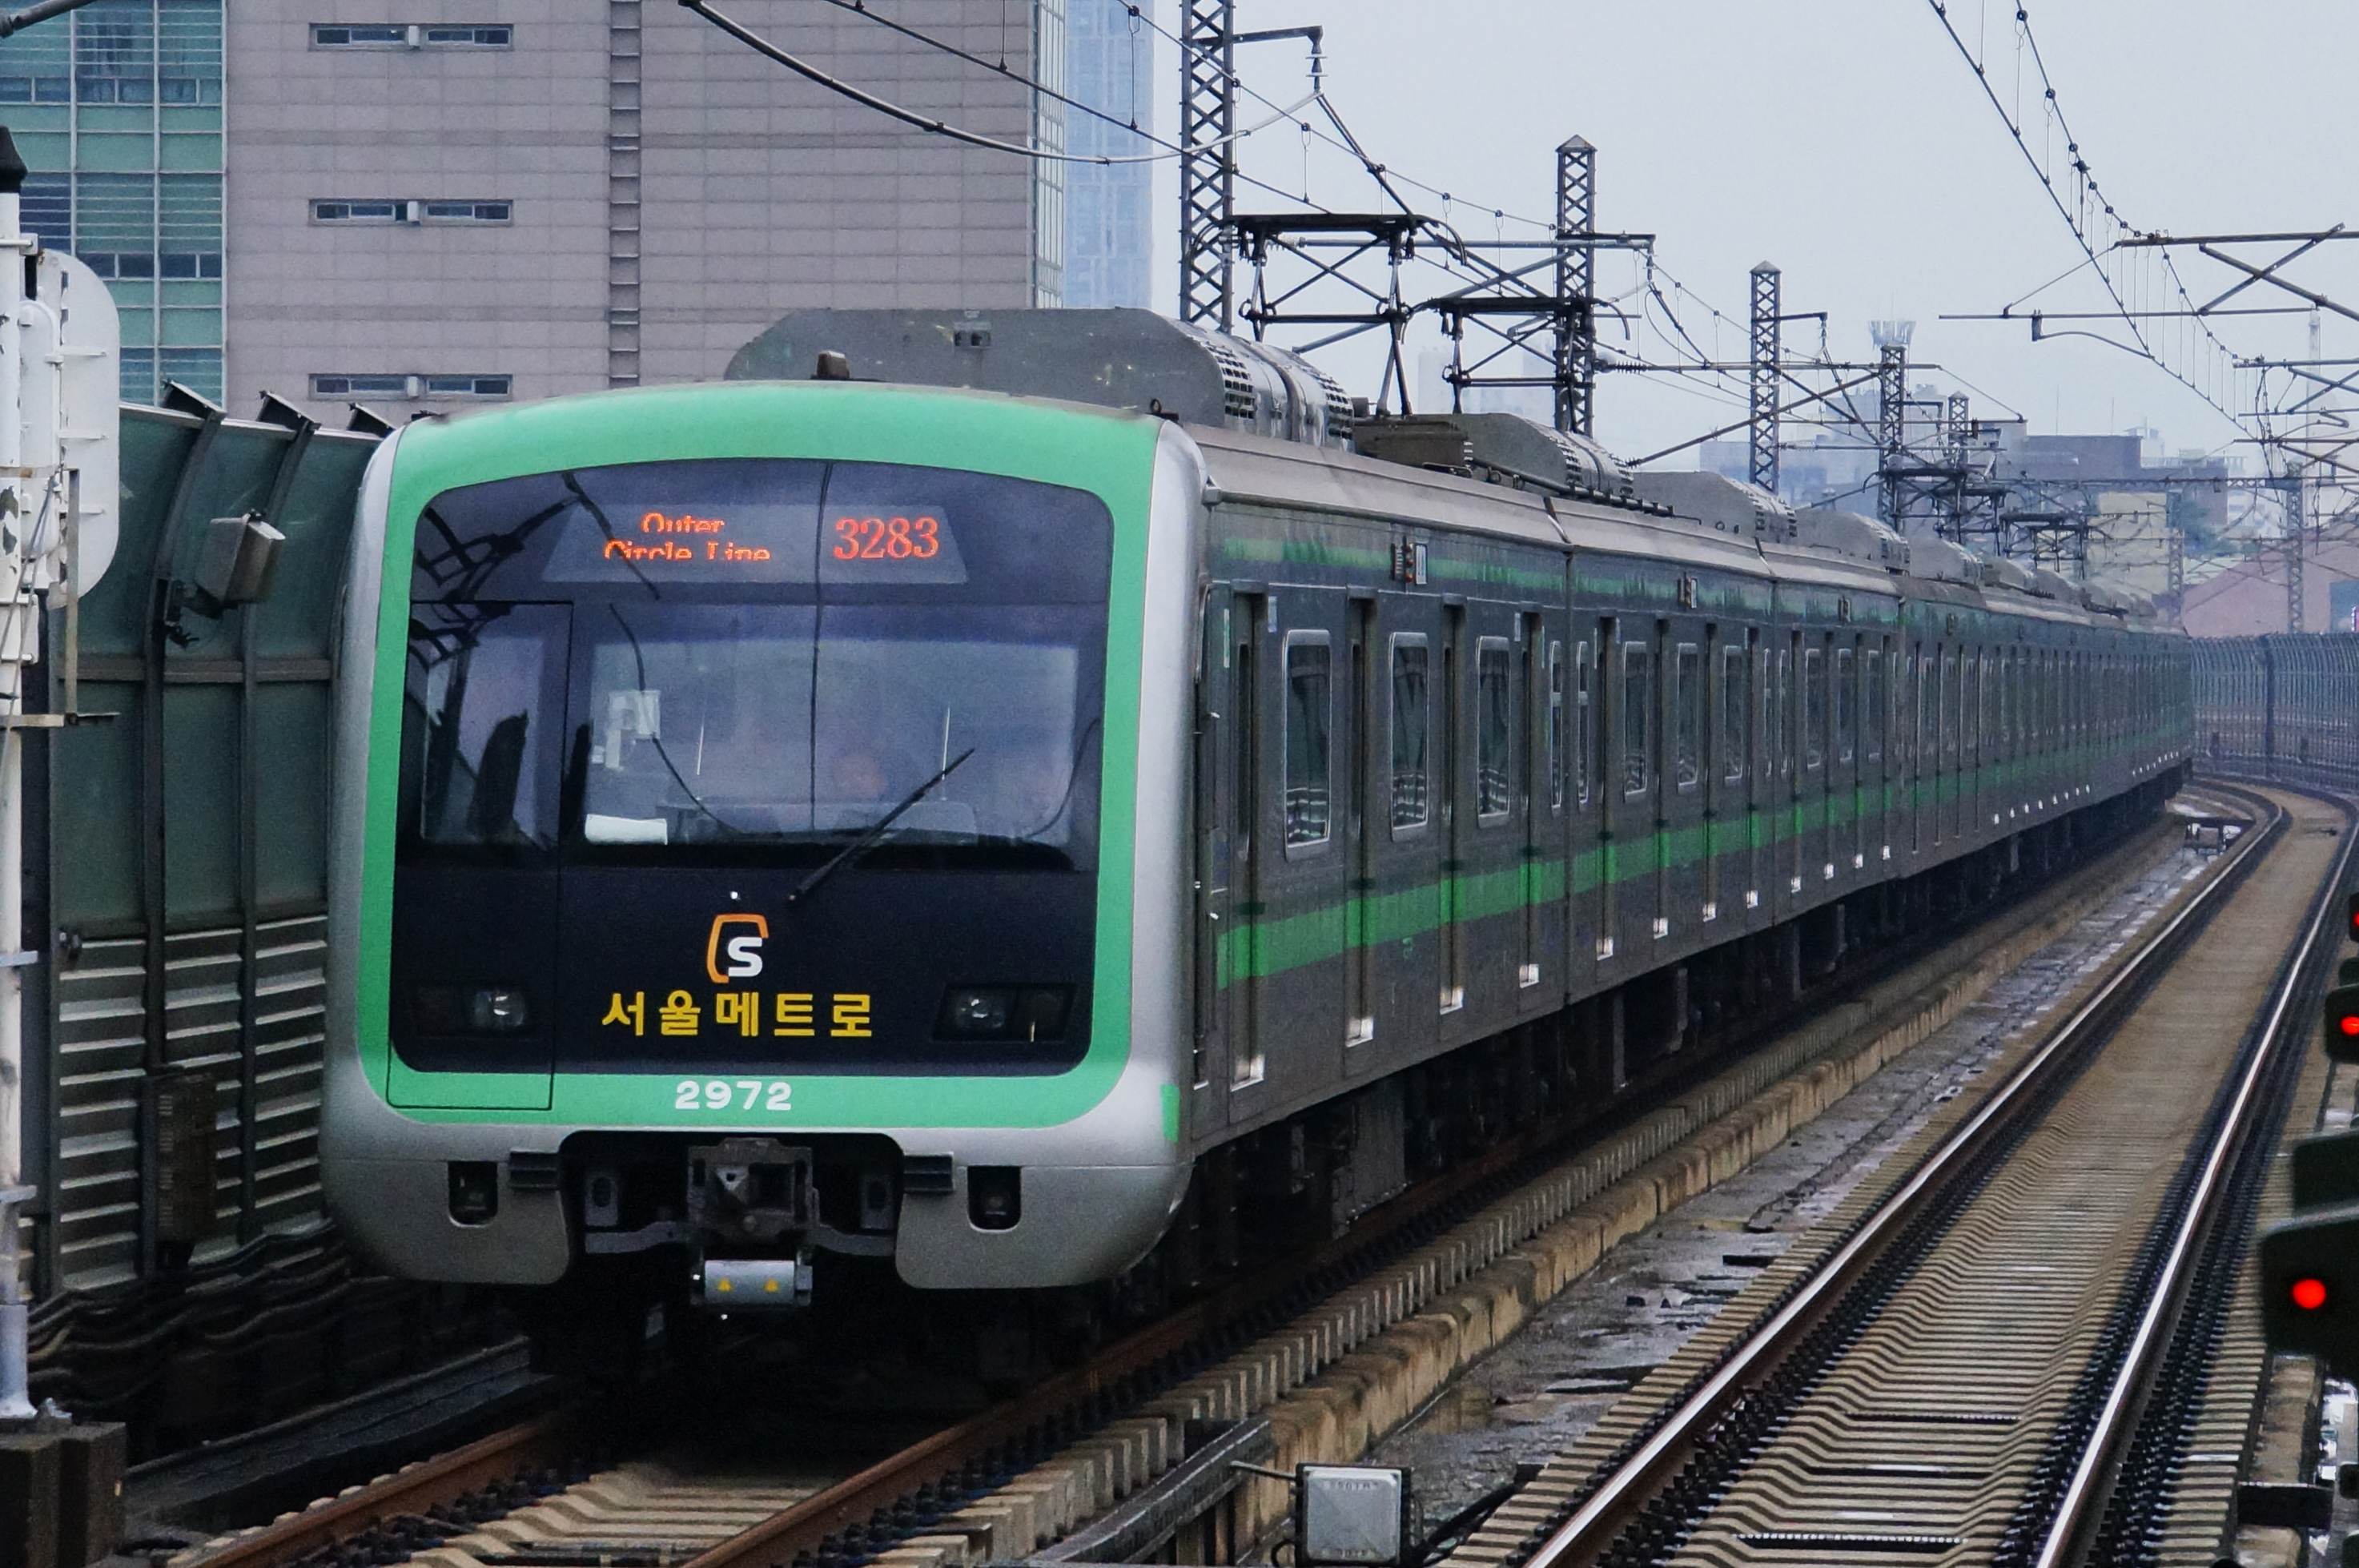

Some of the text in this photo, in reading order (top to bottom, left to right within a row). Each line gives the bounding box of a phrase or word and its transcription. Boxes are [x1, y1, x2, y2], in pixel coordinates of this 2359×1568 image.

[641, 512, 725, 533] Outer
[604, 539, 771, 561] Circle Line
[833, 517, 939, 560] 3283
[602, 990, 872, 1037] 서울메트로
[675, 1080, 792, 1111] 2972
